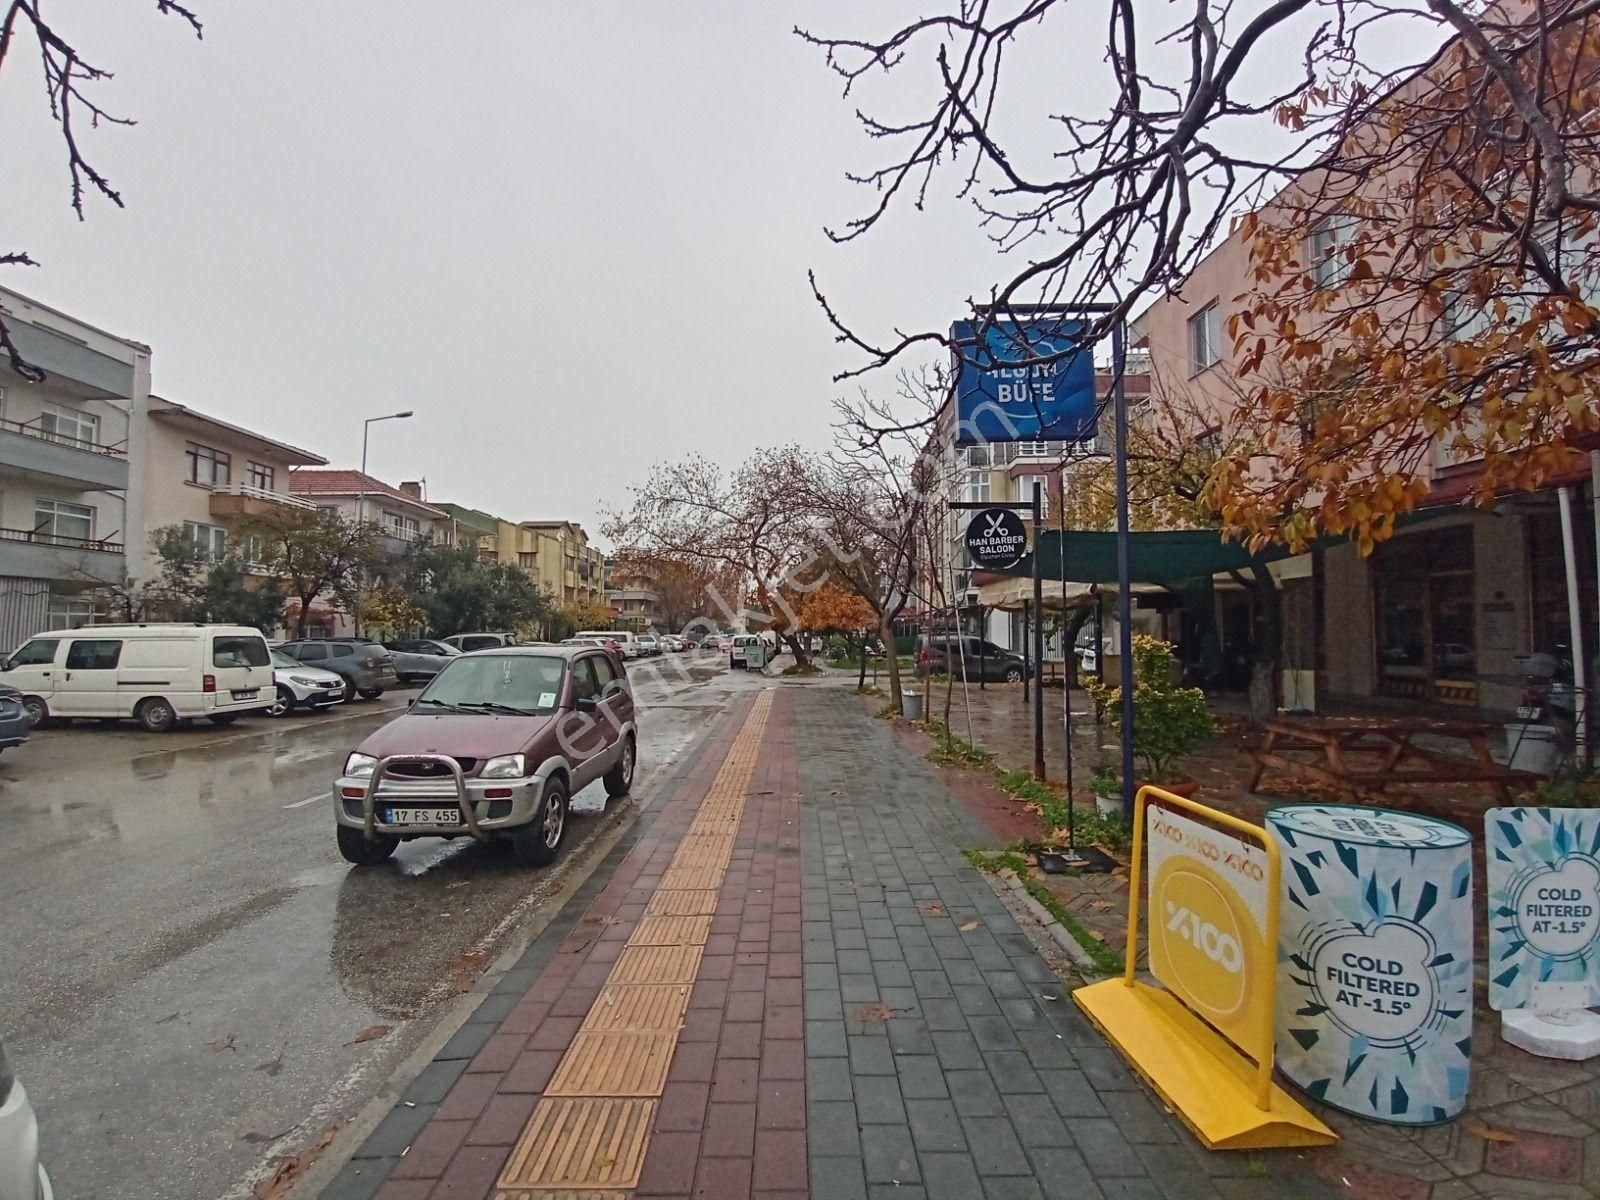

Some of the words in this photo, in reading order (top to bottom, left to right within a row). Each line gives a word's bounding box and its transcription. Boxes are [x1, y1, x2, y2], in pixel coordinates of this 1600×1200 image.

[998, 380, 1056, 403] BÜFE
[969, 538, 988, 546] HAN
[989, 536, 1024, 545] BARBER
[979, 545, 1015, 554] SALOON
[395, 811, 408, 821] 17
[415, 811, 429, 821] FS
[435, 811, 458, 821] 455
[1538, 888, 1581, 901] COLD
[1526, 904, 1592, 917] FILTERED
[1342, 952, 1403, 976] COLD
[1327, 966, 1420, 997] FILTERED
